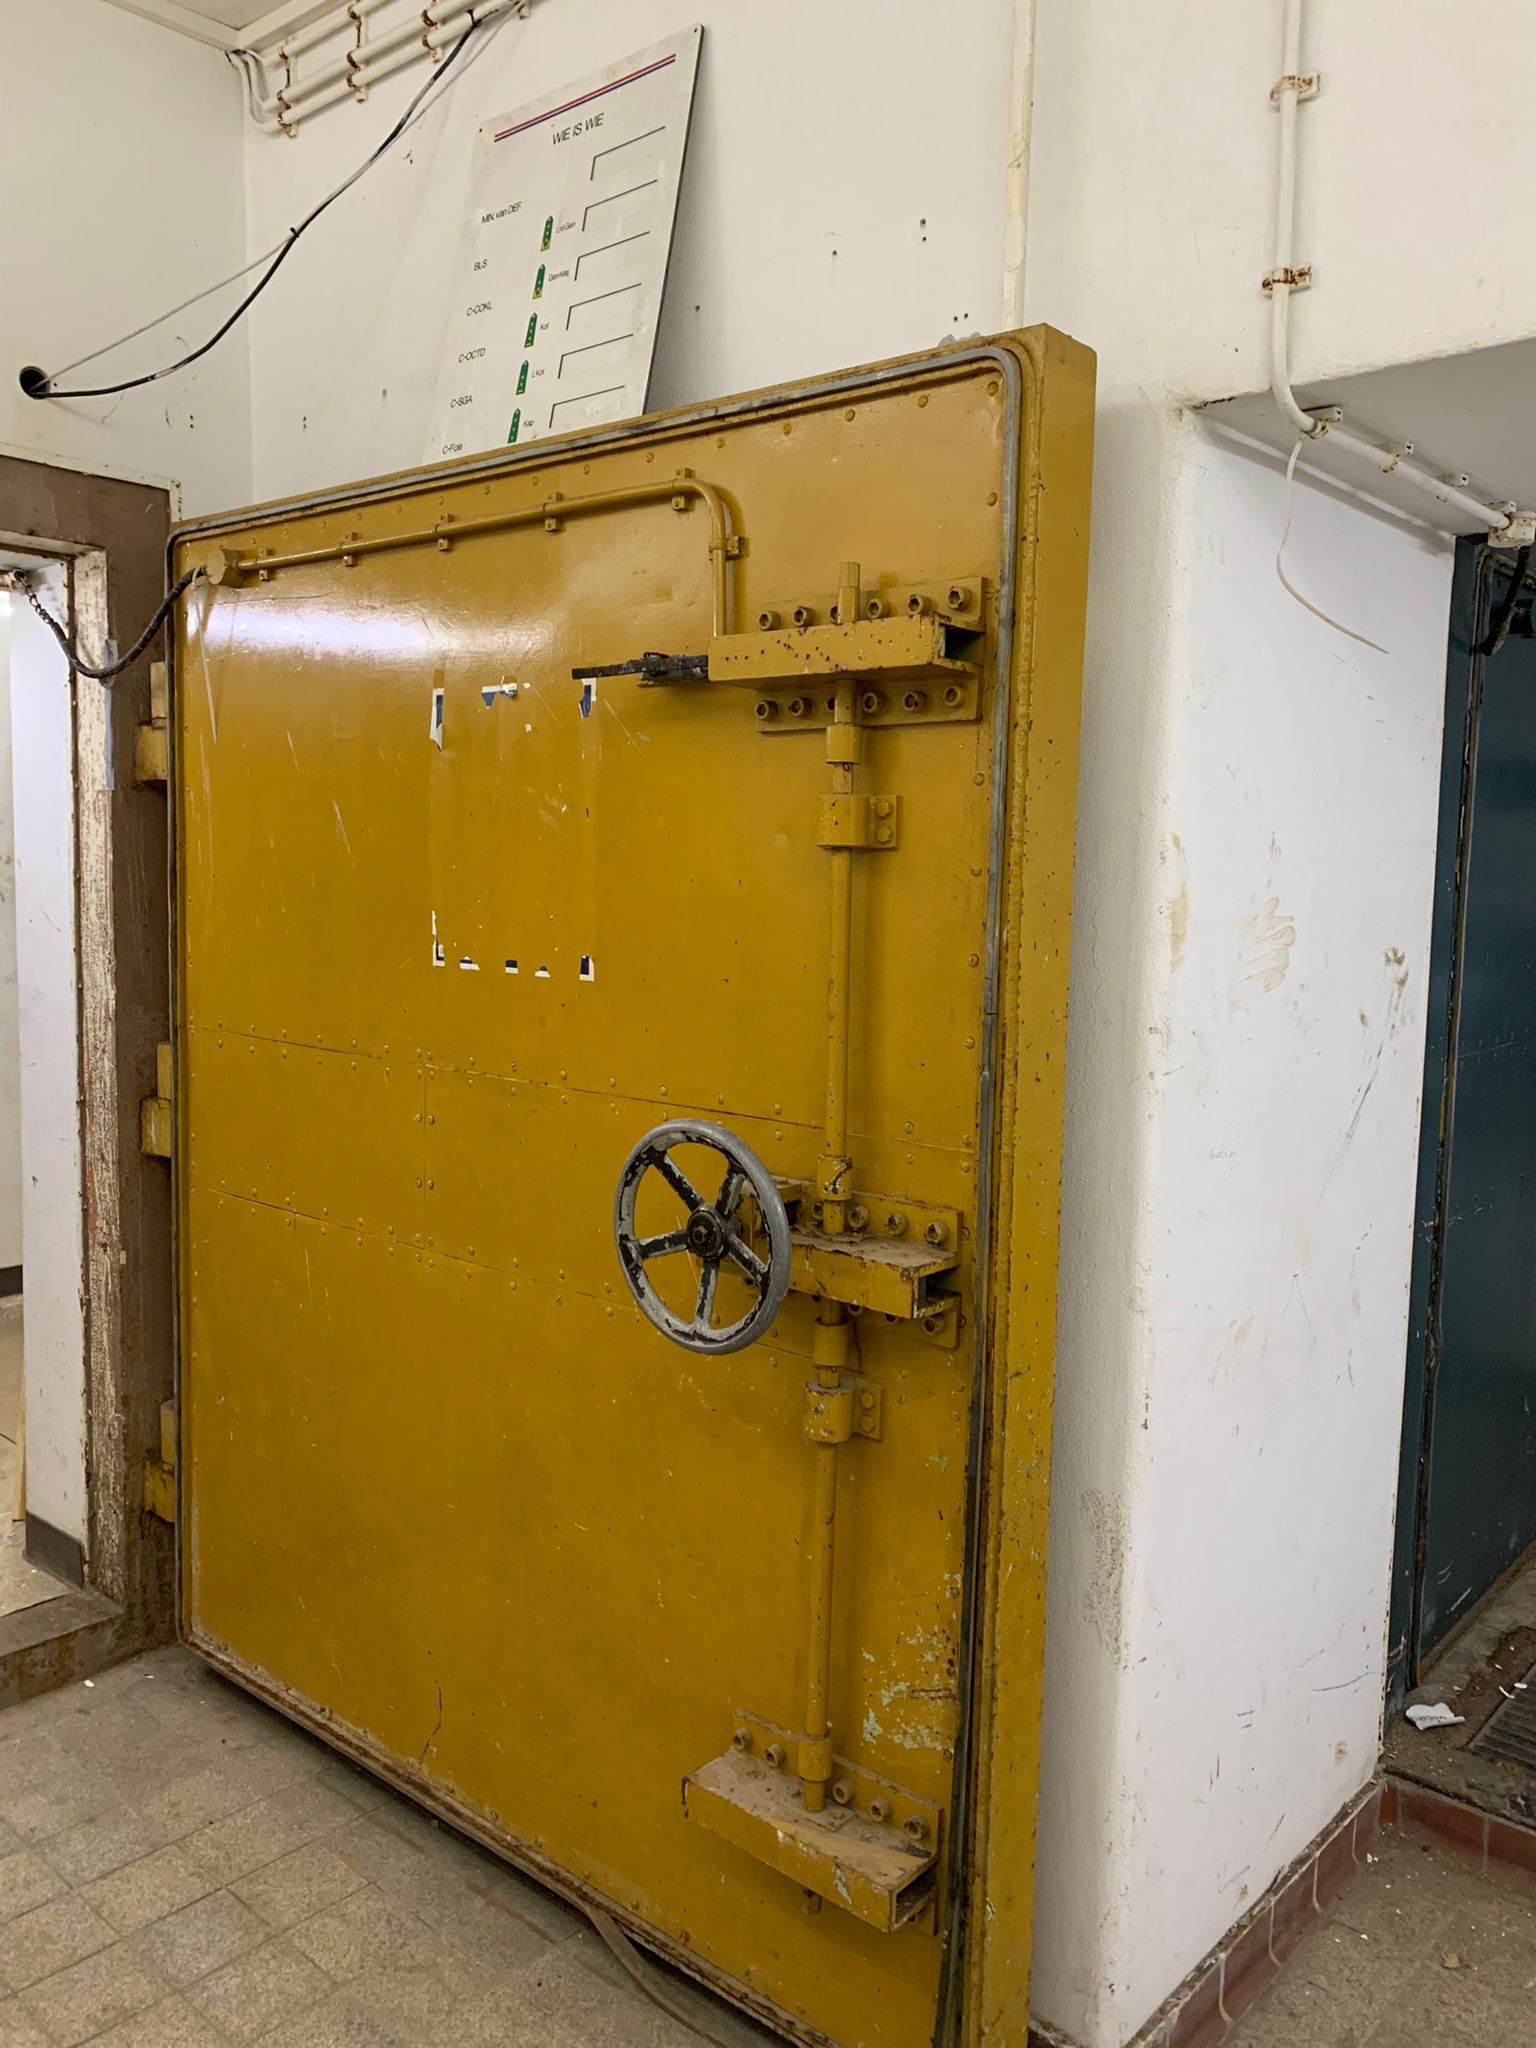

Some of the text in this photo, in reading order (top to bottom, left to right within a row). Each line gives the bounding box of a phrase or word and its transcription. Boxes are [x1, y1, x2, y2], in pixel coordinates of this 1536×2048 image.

[553, 112, 604, 145] WIE IS WIE
